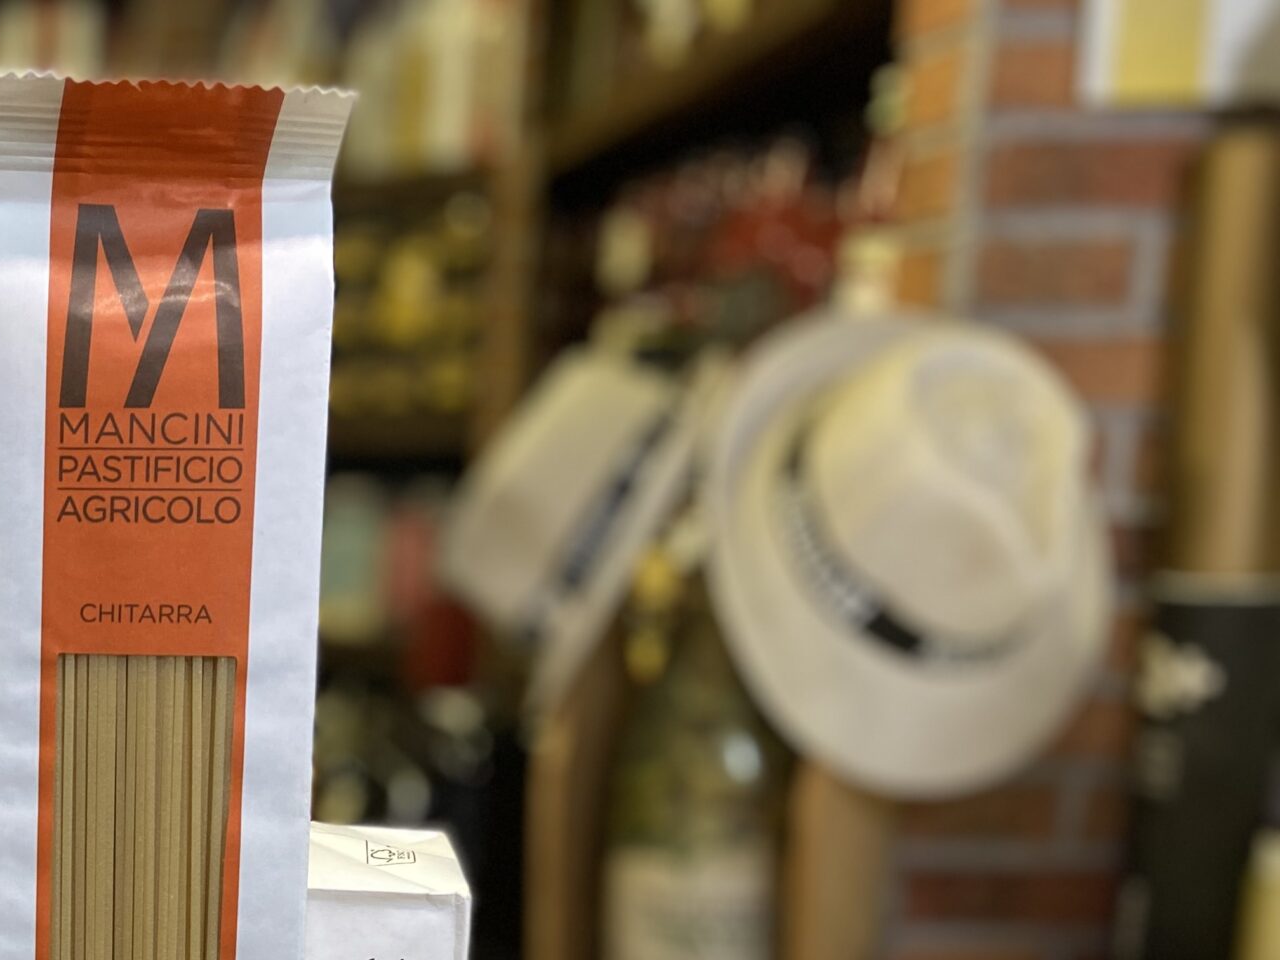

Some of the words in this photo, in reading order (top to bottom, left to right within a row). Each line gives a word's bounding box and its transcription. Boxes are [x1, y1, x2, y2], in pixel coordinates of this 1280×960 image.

[58, 412, 244, 445] MANCINI
[58, 455, 243, 484] PASTIFICIO
[56, 495, 241, 525] AGRICOLO
[79, 603, 212, 625] CHITARRA
